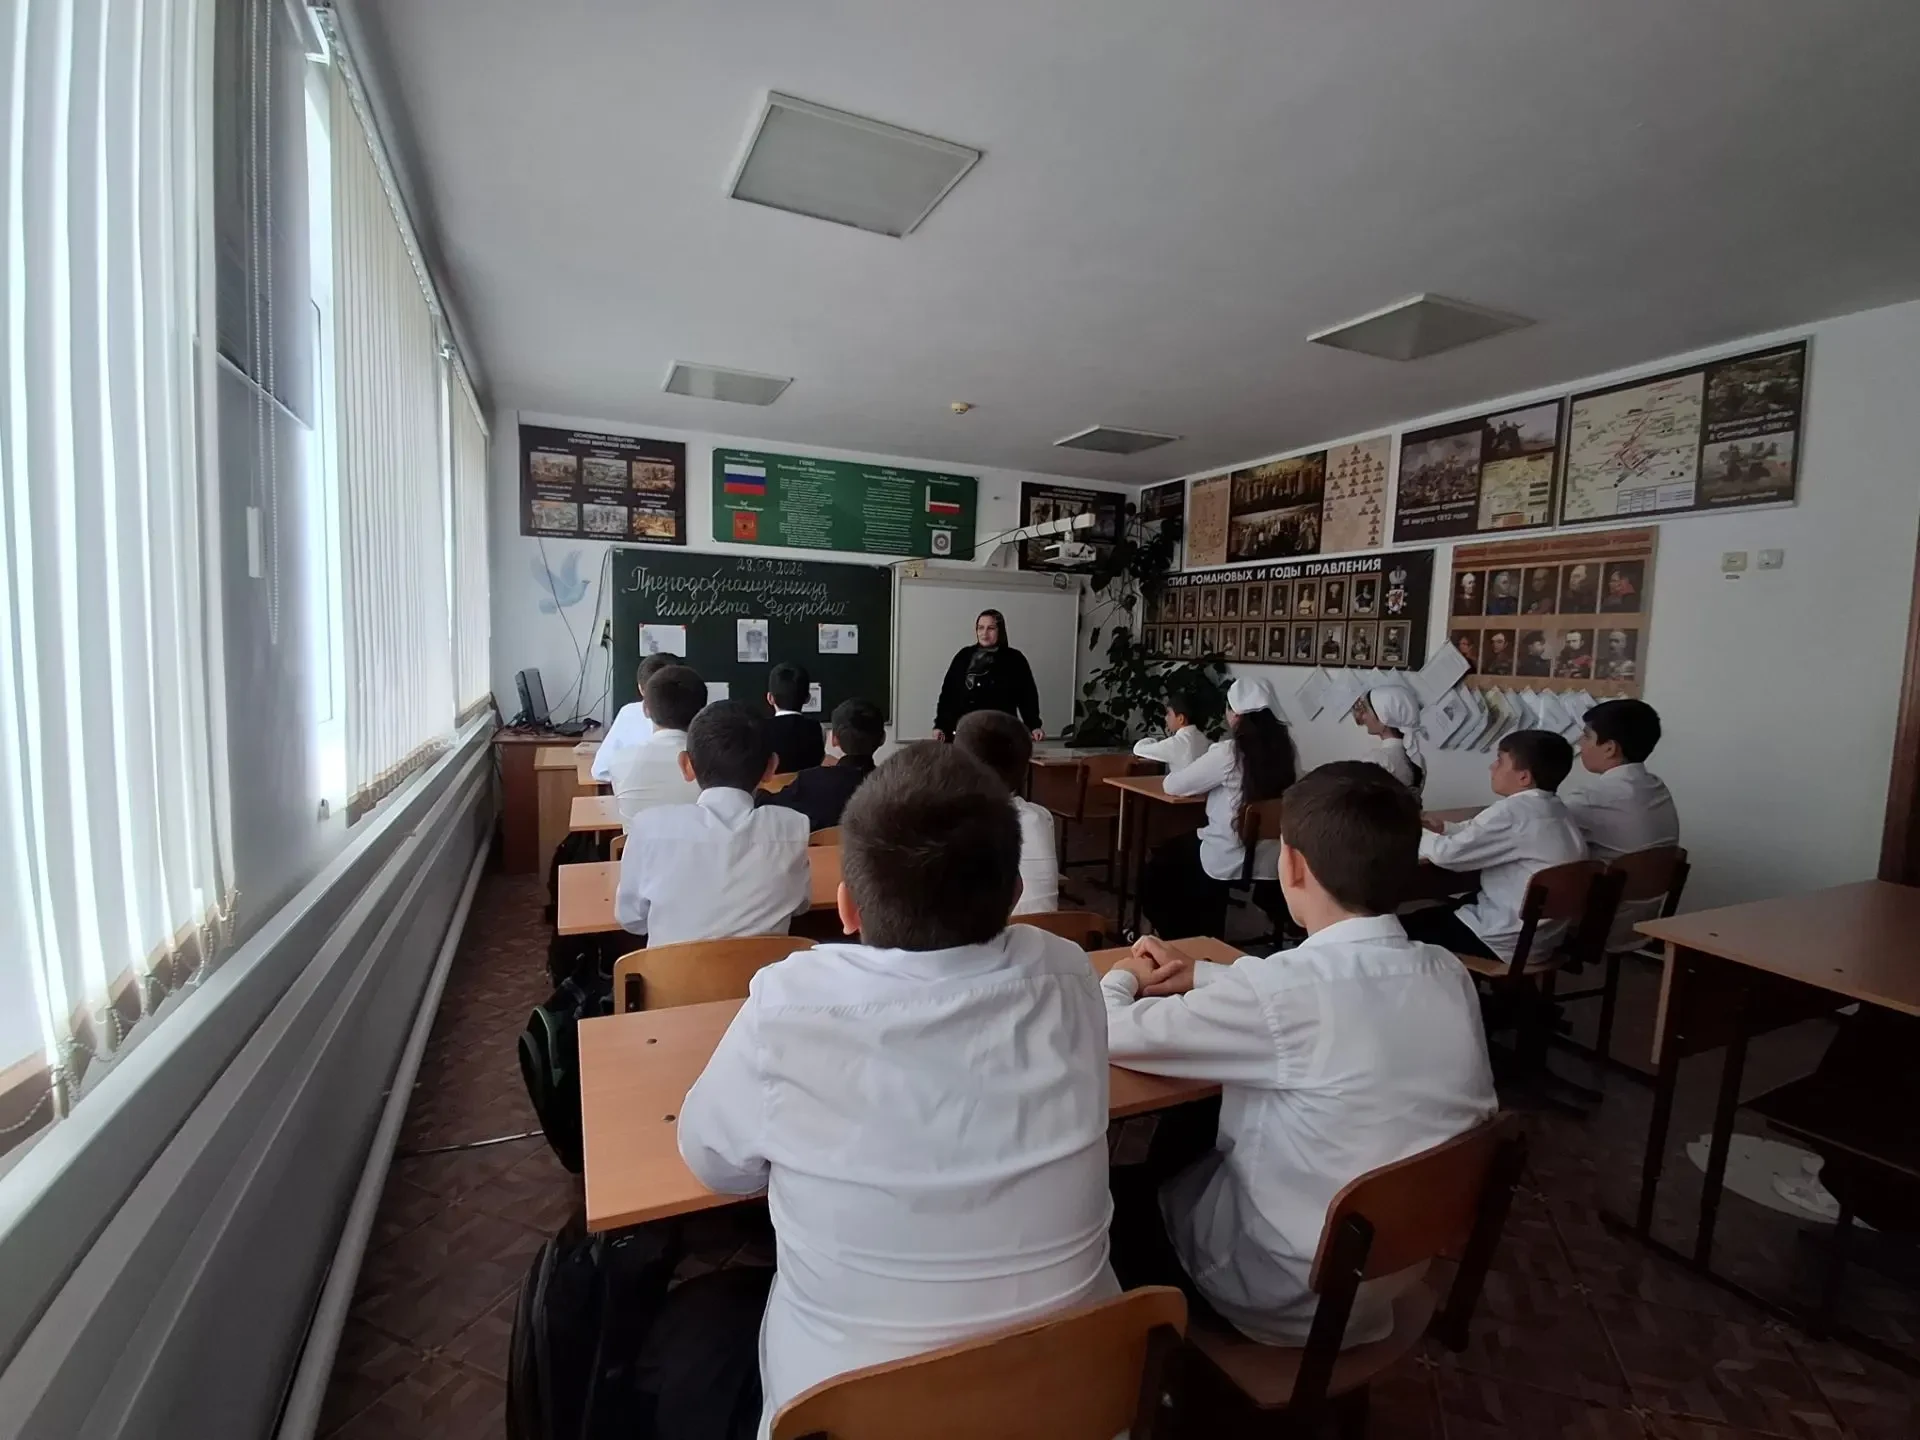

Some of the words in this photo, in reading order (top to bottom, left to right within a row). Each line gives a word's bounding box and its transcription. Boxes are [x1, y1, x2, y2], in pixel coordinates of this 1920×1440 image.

[1190, 569, 1252, 585] РОМАНОВЫХ
[1257, 568, 1265, 579] И
[1269, 565, 1301, 579] ГОДЫ
[1305, 558, 1381, 575] ПРАВЛЕНИЯ
